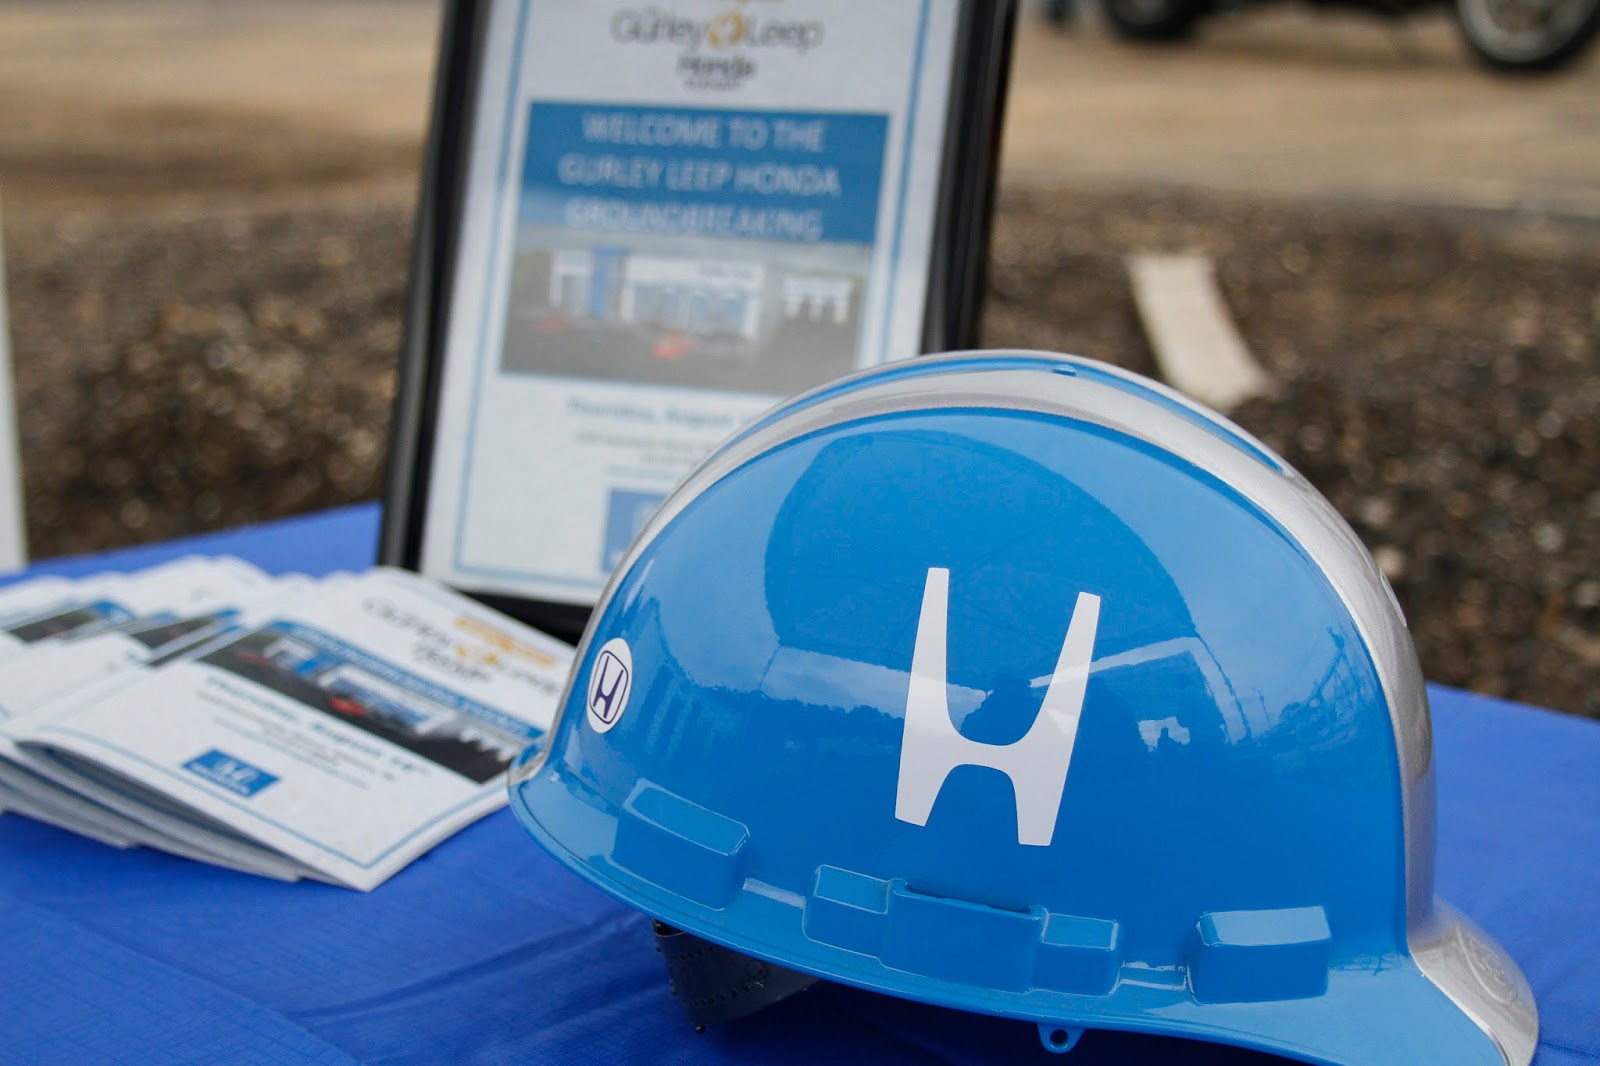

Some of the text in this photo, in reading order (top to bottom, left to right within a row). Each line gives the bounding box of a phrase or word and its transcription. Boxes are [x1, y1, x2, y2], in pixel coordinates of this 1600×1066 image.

[745, 17, 824, 52] Leep
[583, 112, 824, 151] WELCOME TO THE
[558, 153, 841, 197] GURLEY LEEP HONDA
[566, 197, 824, 241] GROUNDBREAKING
